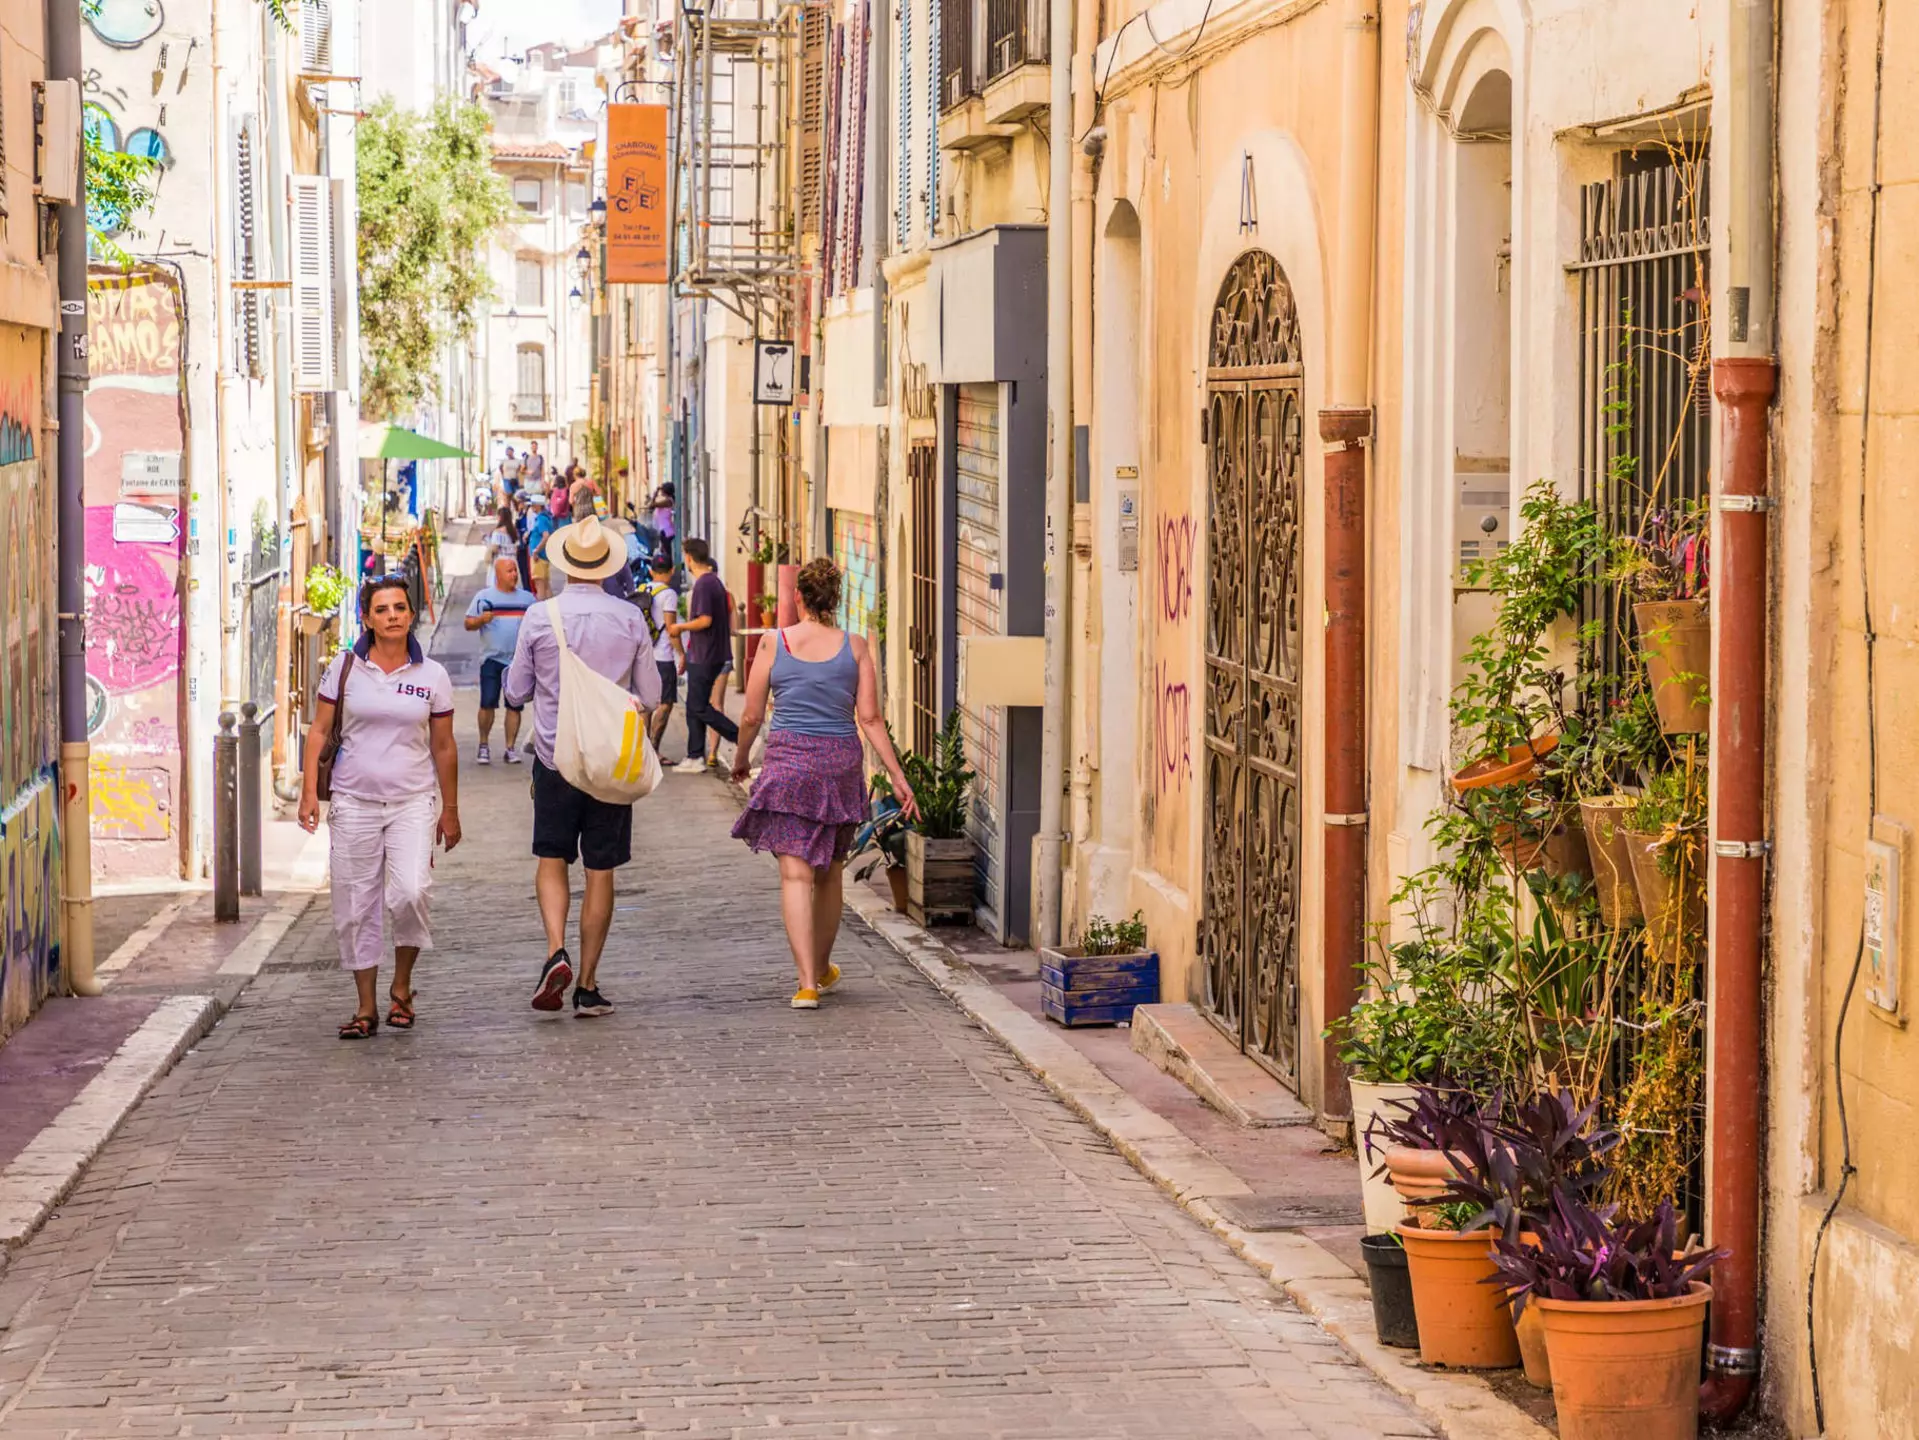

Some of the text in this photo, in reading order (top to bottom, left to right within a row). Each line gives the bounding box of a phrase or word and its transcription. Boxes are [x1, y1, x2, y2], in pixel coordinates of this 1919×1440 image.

[625, 177, 636, 190] F
[616, 193, 650, 211] C E
[146, 465, 159, 473] RUE
[396, 683, 431, 701] 1961
